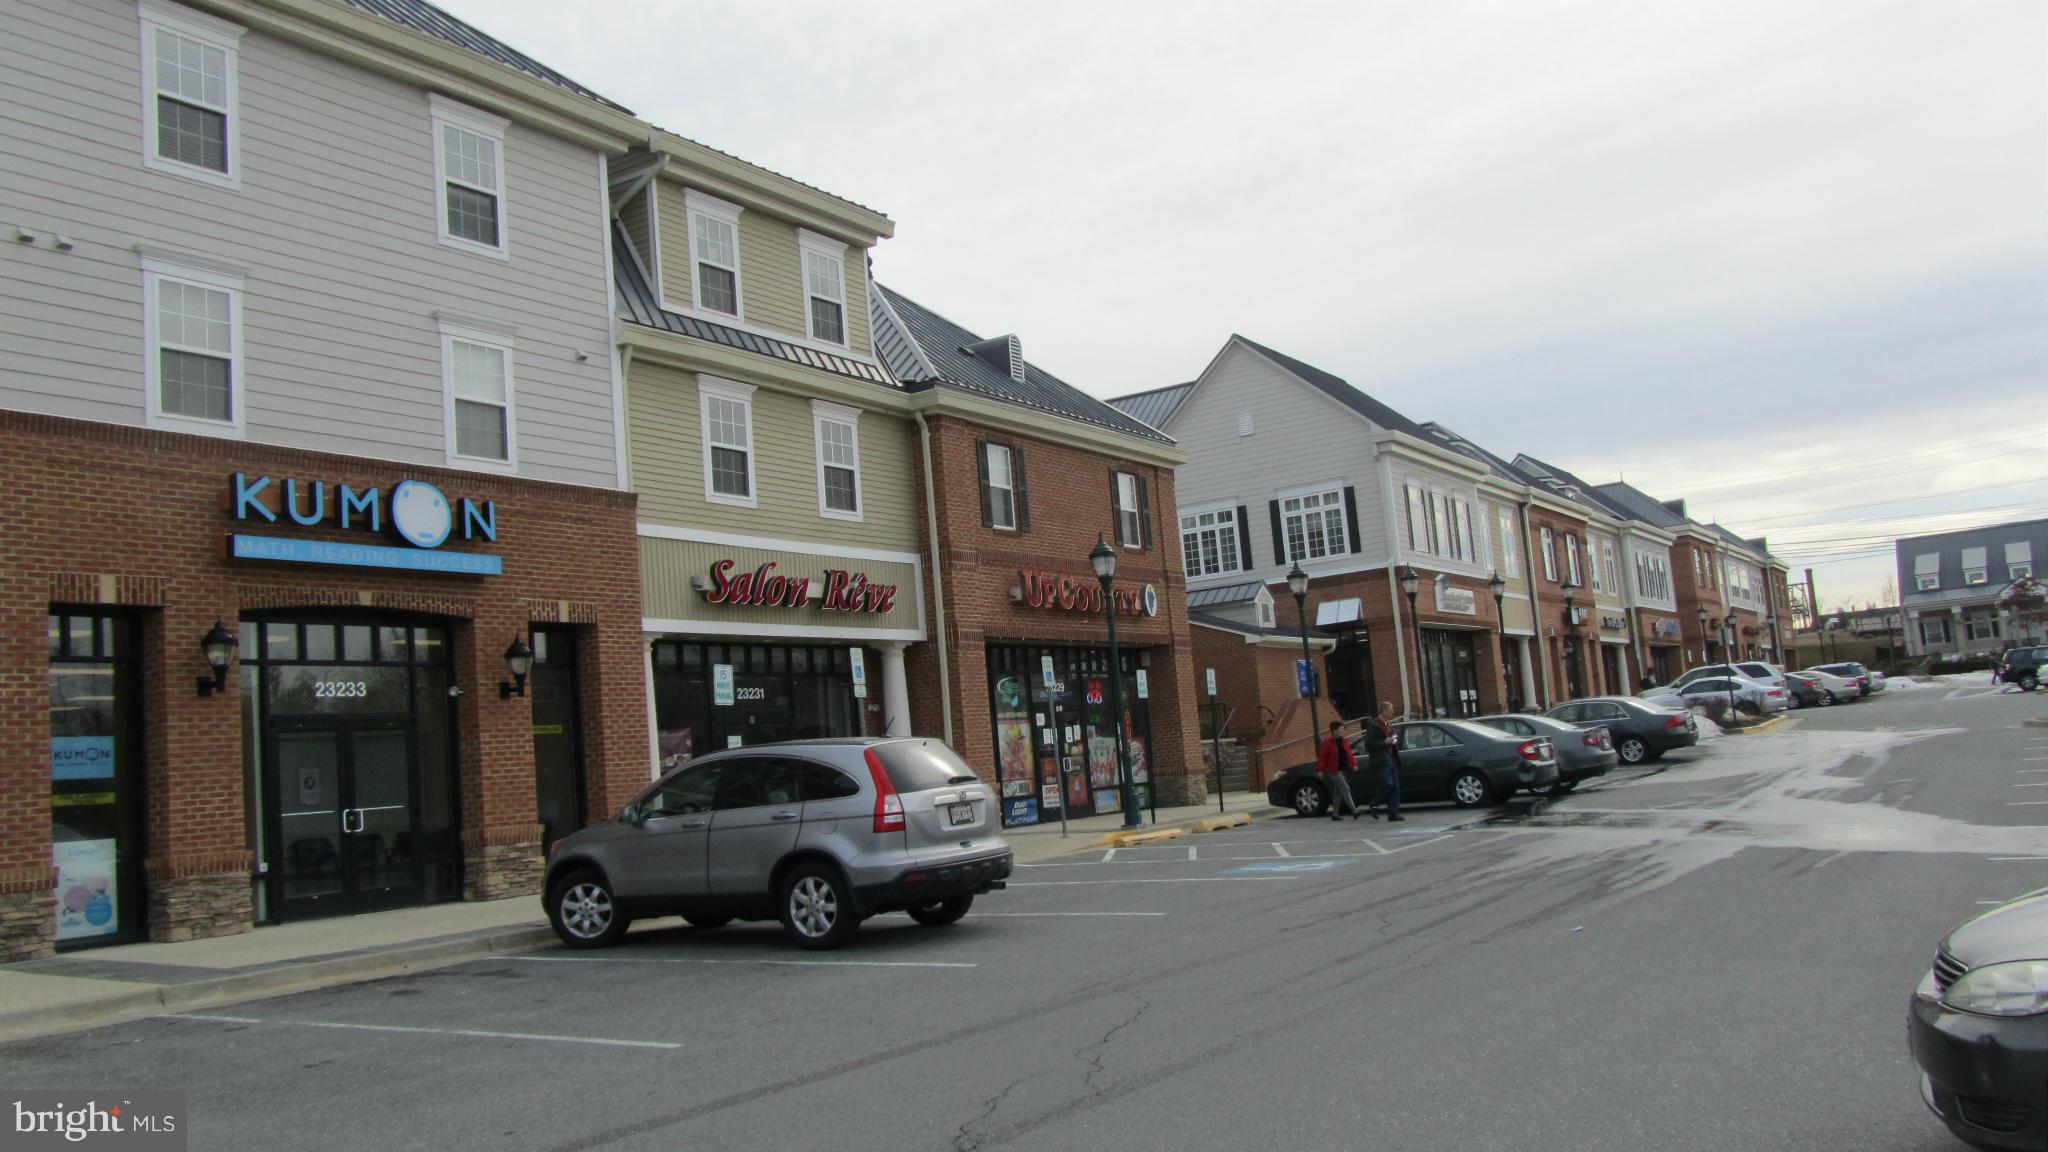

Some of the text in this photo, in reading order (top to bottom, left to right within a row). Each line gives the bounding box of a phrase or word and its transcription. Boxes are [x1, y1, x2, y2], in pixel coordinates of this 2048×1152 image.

[232, 472, 496, 548] KUMON
[707, 559, 897, 614] Salon Rêve
[315, 681, 367, 697] 23233
[737, 687, 765, 699] 23231
[54, 748, 111, 761] KUMON
